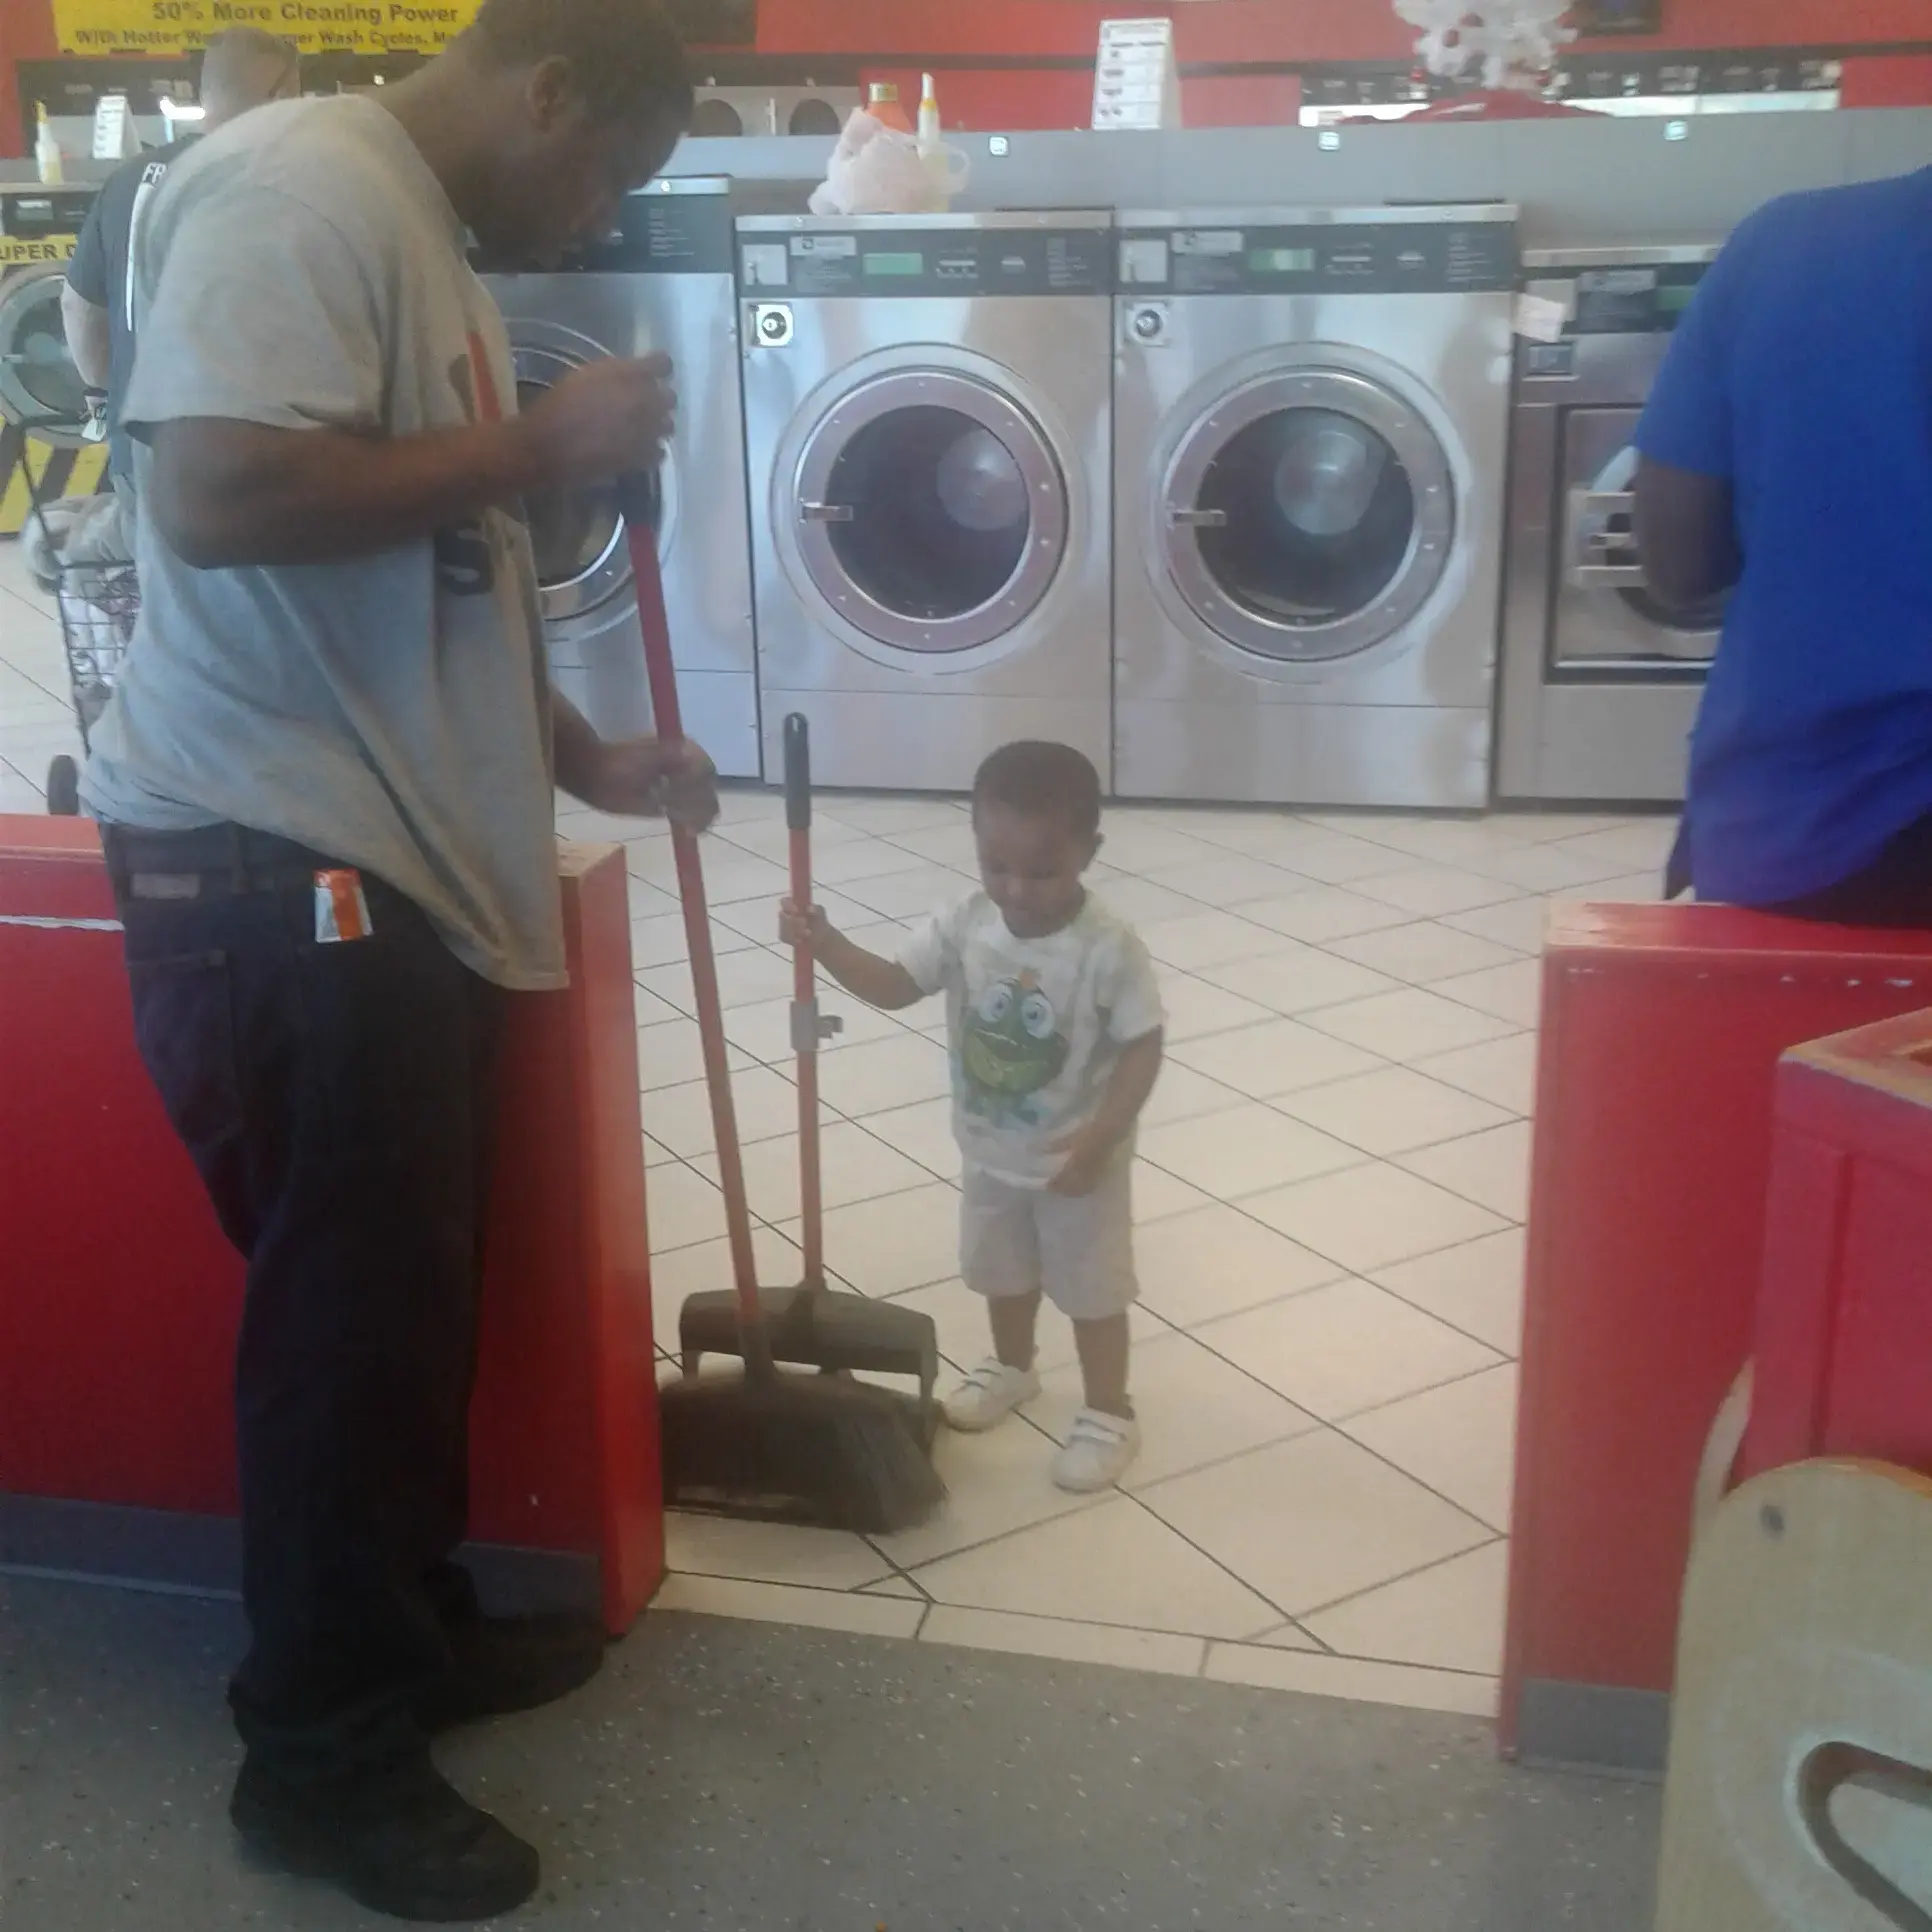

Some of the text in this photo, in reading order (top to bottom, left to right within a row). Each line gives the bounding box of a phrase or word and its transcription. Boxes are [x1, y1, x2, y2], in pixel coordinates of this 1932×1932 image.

[153, 1, 458, 25] 50% More Cleaning Power
[75, 29, 117, 45] With
[123, 29, 181, 44] Hotter
[319, 30, 364, 45] Wash
[0, 244, 58, 261] UPER
